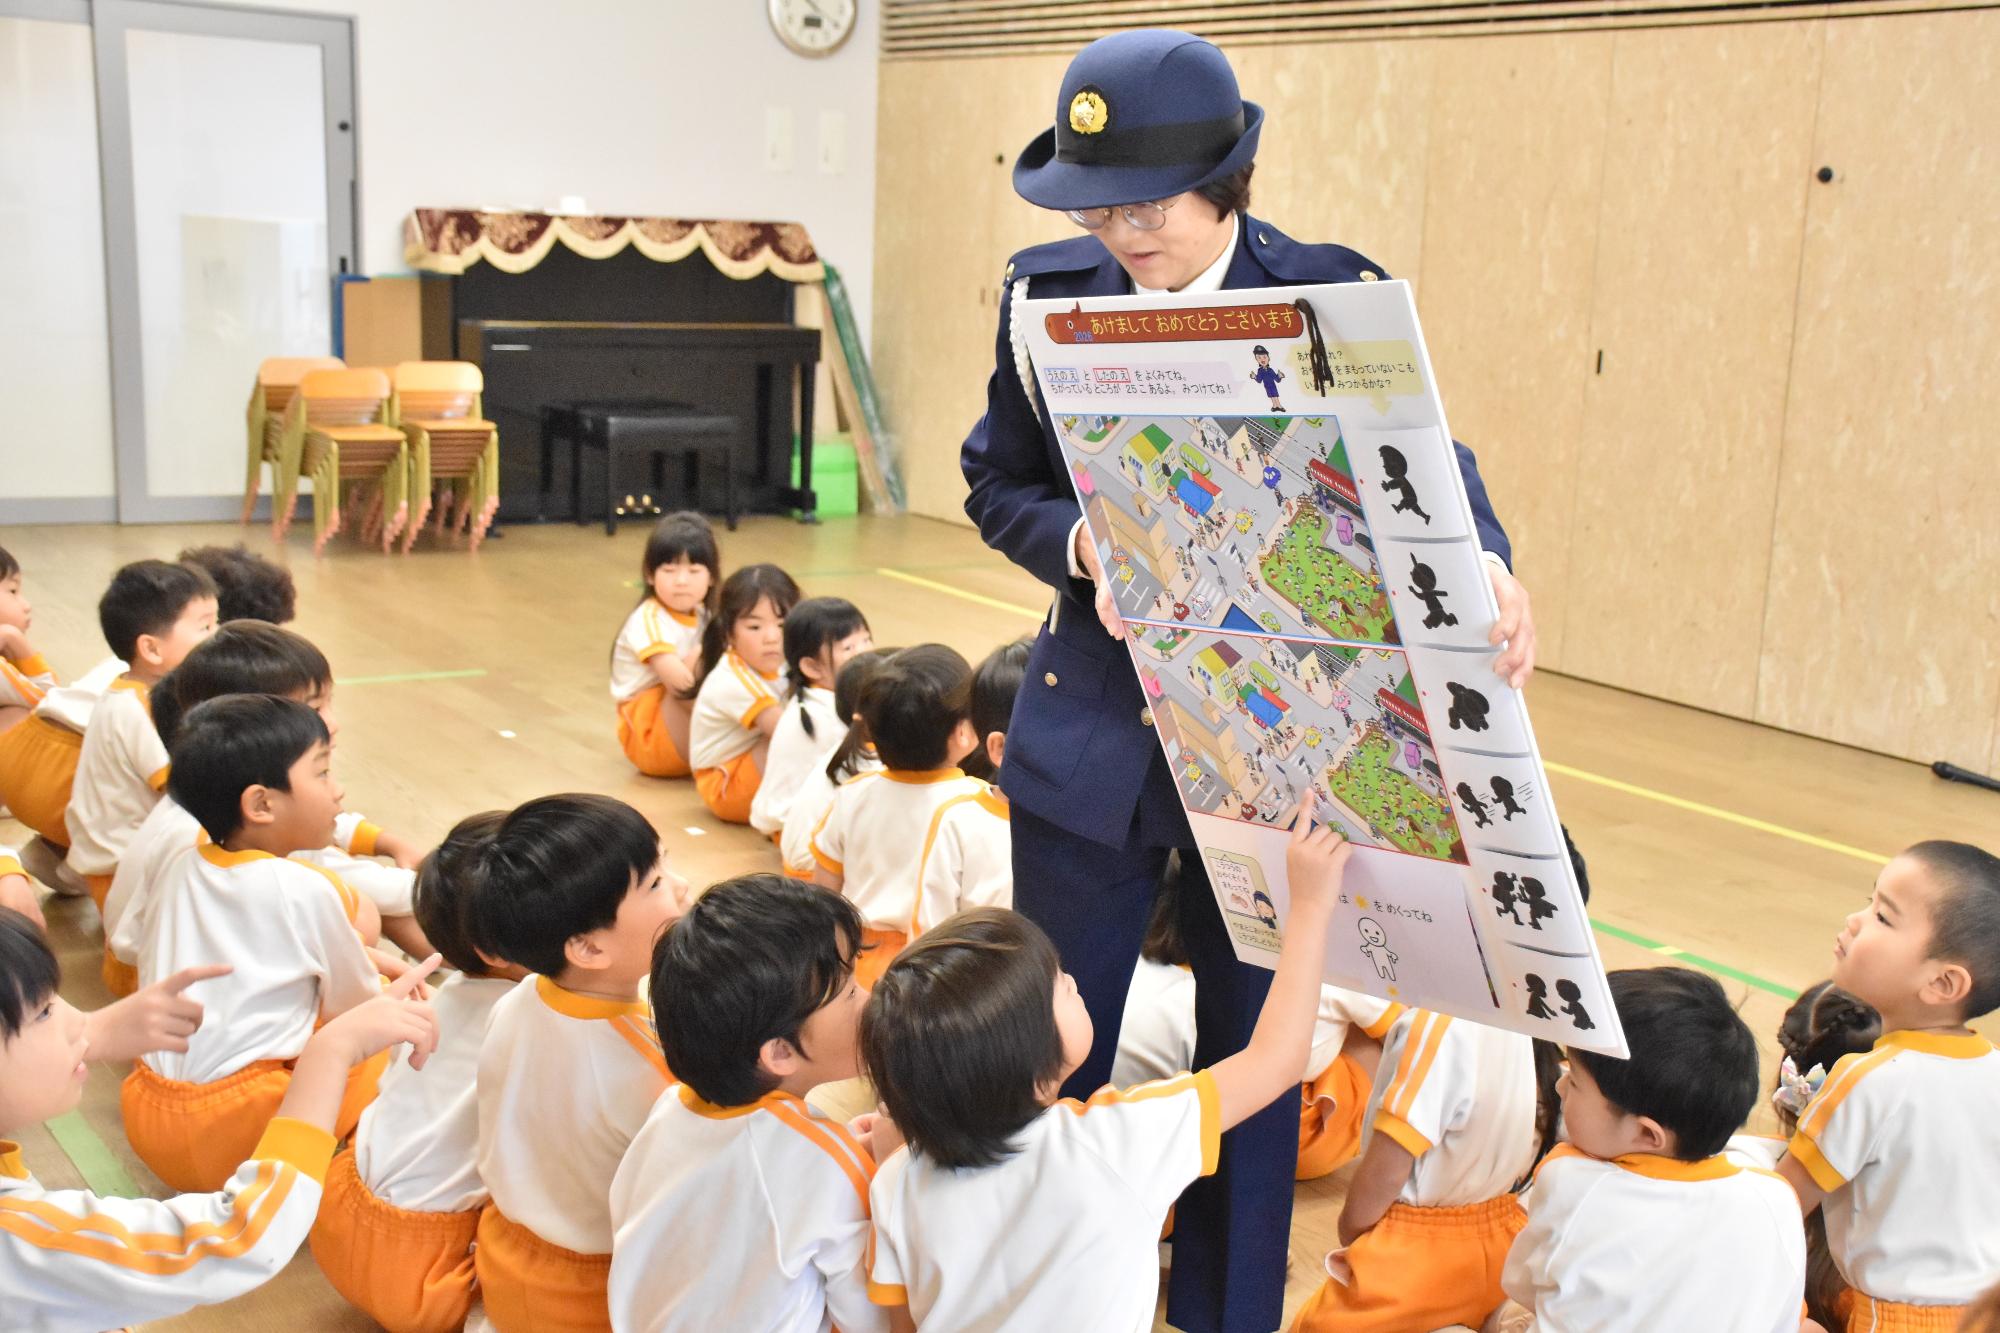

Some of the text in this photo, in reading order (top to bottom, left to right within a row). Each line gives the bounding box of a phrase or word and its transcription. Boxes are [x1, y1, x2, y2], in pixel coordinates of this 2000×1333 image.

[1090, 308, 1294, 335] あけまして おめでとう ございます
